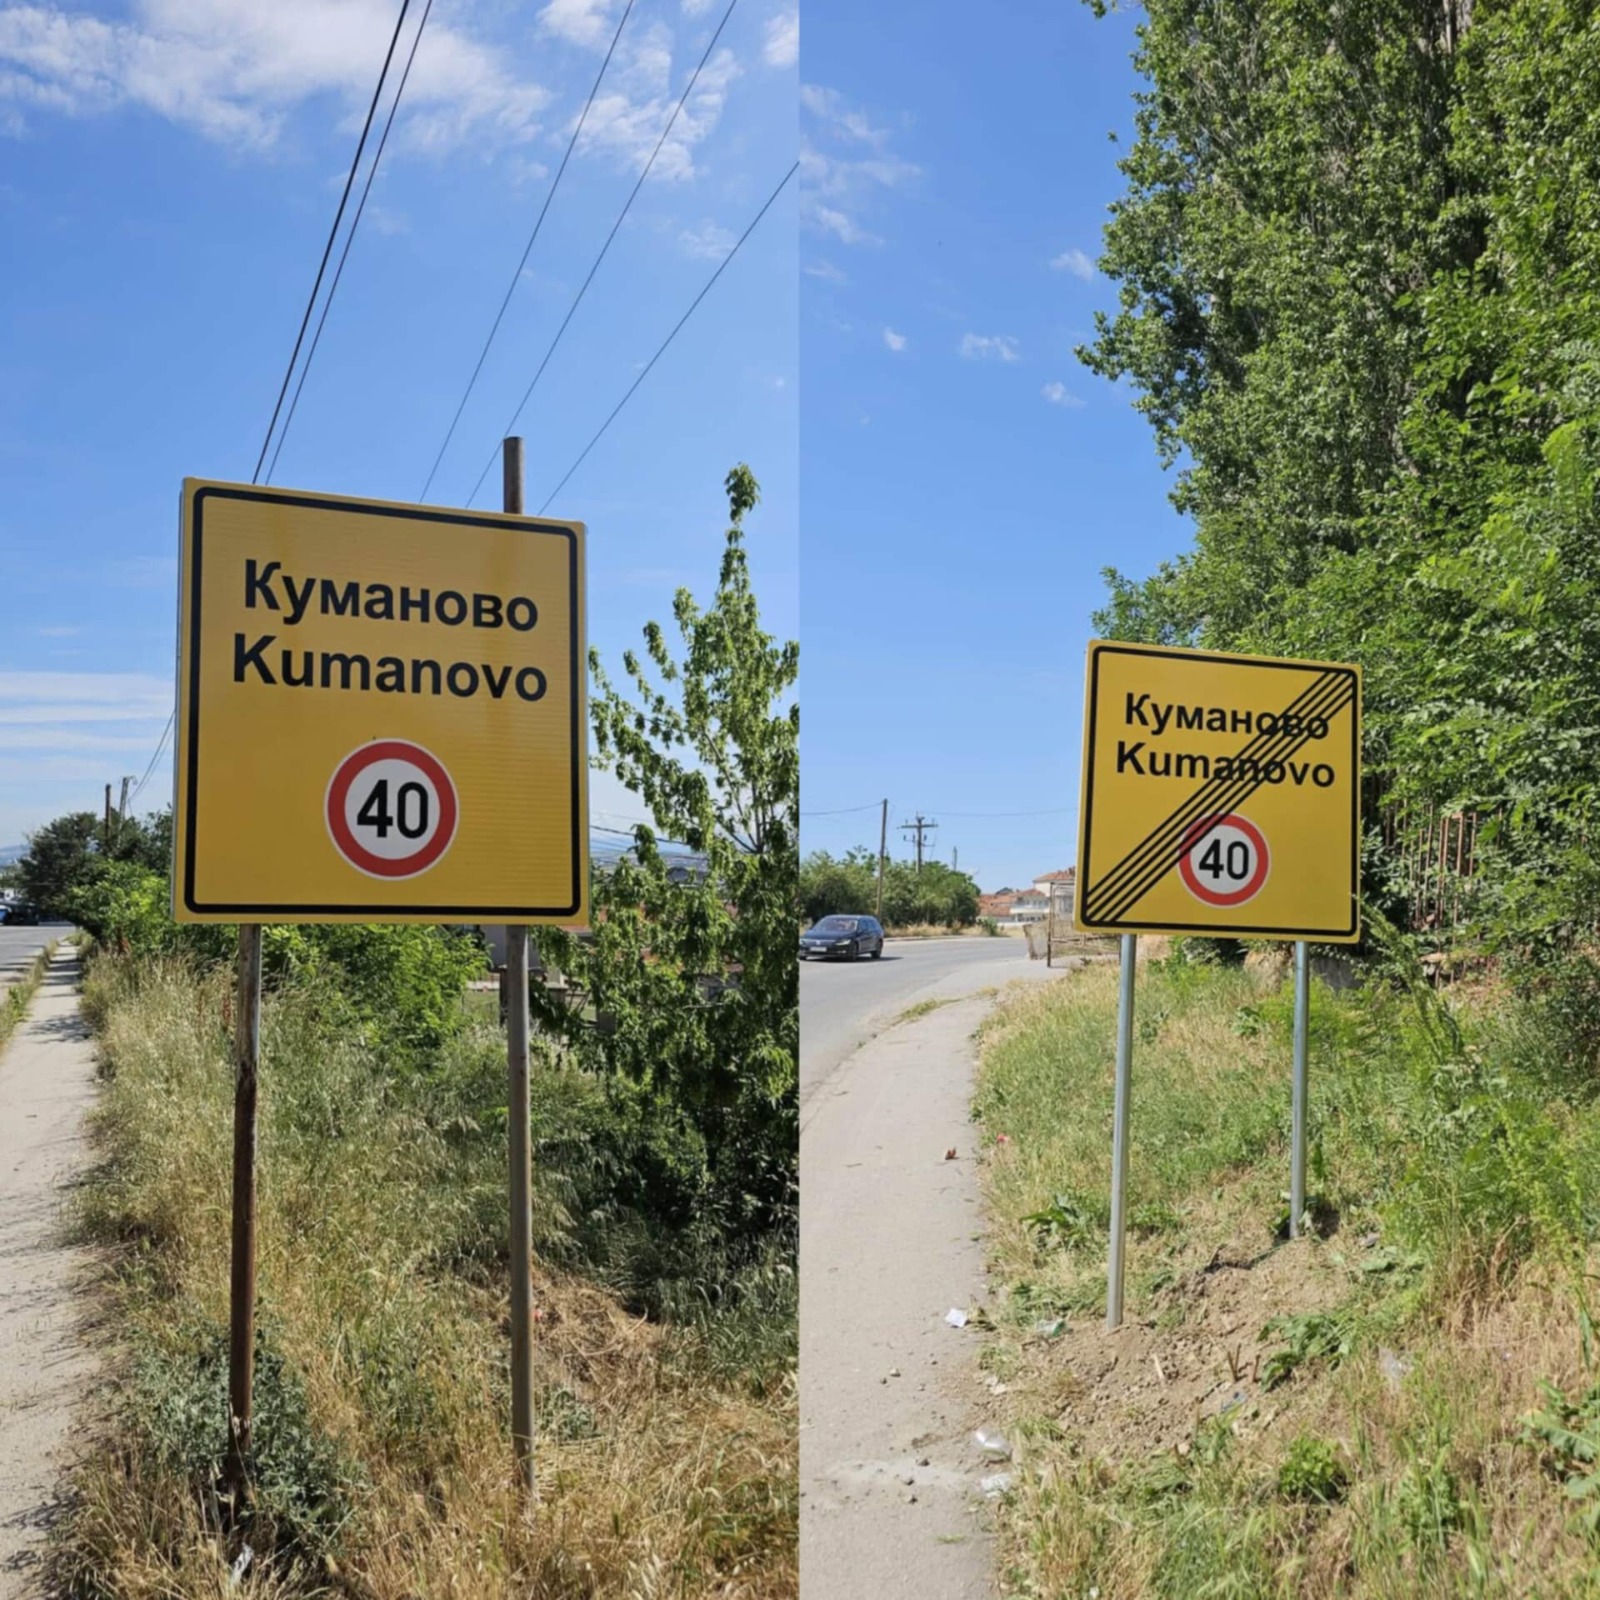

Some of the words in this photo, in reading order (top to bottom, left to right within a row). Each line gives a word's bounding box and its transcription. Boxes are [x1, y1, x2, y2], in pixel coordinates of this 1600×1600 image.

[244, 558, 539, 632] Куманово
[233, 632, 548, 702] Kumanovo
[1124, 692, 1330, 740] Куманово
[1116, 740, 1336, 788] Kumanovo
[356, 779, 429, 839] 40
[1198, 838, 1250, 880] 40
